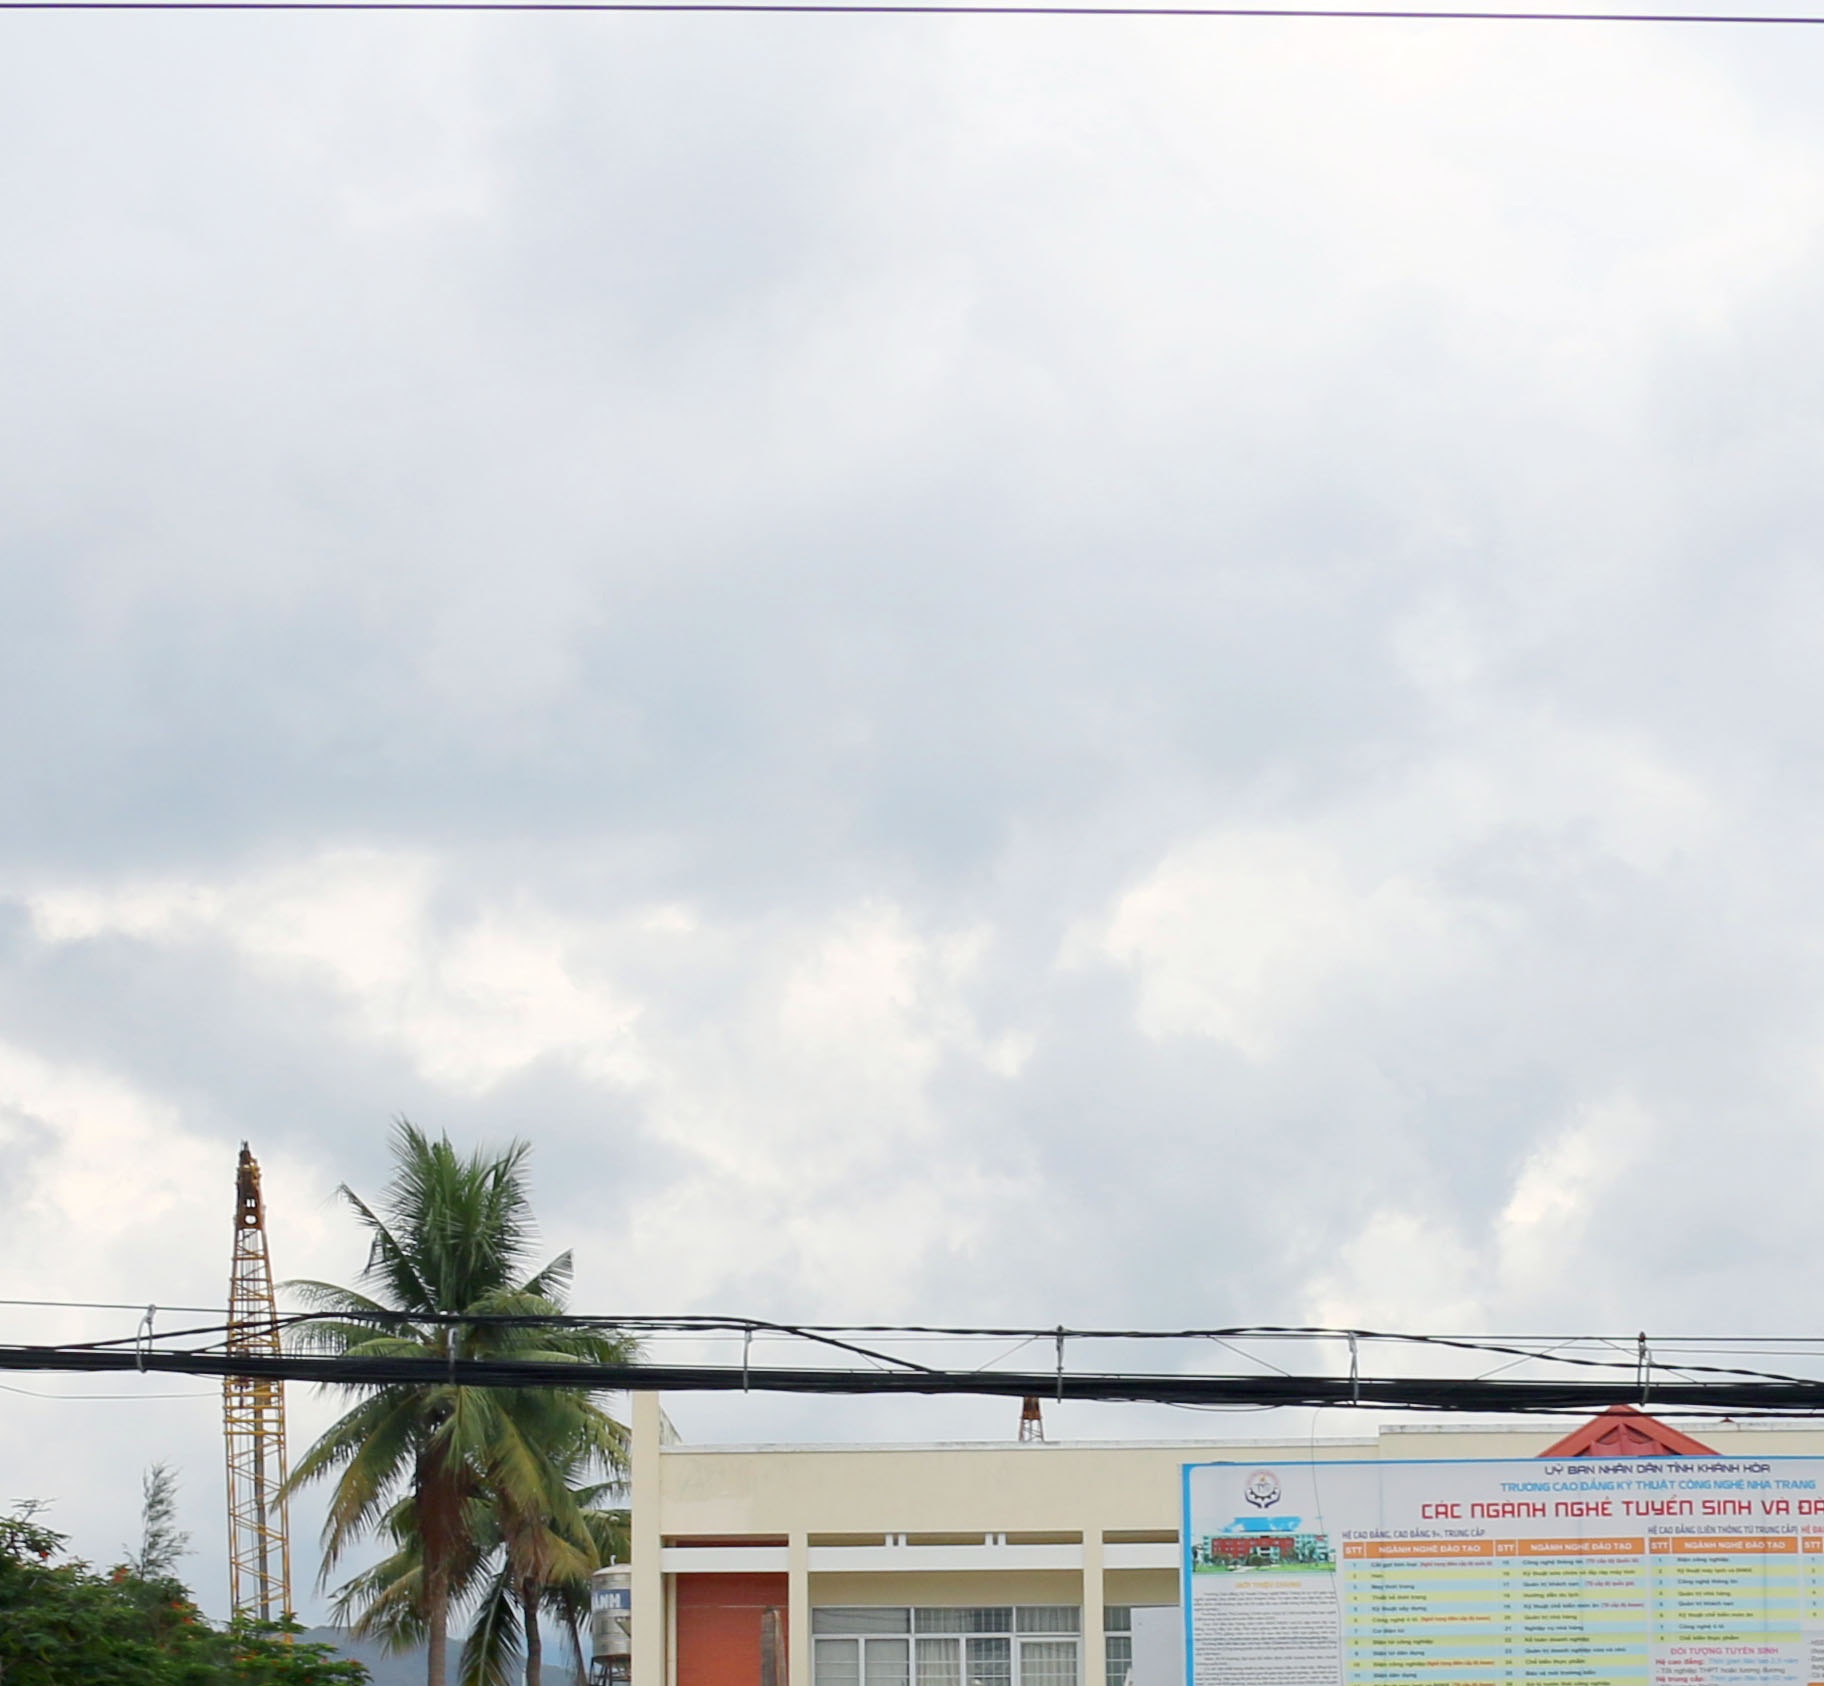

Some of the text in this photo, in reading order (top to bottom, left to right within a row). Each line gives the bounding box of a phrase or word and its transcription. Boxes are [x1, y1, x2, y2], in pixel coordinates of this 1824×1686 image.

[1567, 1464, 1595, 1475] BAN
[1598, 1464, 1633, 1475] NHÂN
[1637, 1463, 1664, 1475] DÂN
[1552, 1479, 1578, 1492] CAO
[1678, 1478, 1712, 1491] CÔNG
[1747, 1478, 1771, 1491] NHA
[1775, 1478, 1816, 1491] TRANG
[1421, 1500, 1463, 1519] CÁC
[1470, 1499, 1547, 1518] NGÀNH
[1701, 1500, 1753, 1516] SINH
[1761, 1496, 1790, 1516] VÀ
[1498, 1544, 1515, 1553] STT
[1650, 1541, 1669, 1550] STT
[1804, 1541, 1821, 1550] STT
[1345, 1546, 1363, 1555] STT
[1757, 1646, 1779, 1655] SINH
